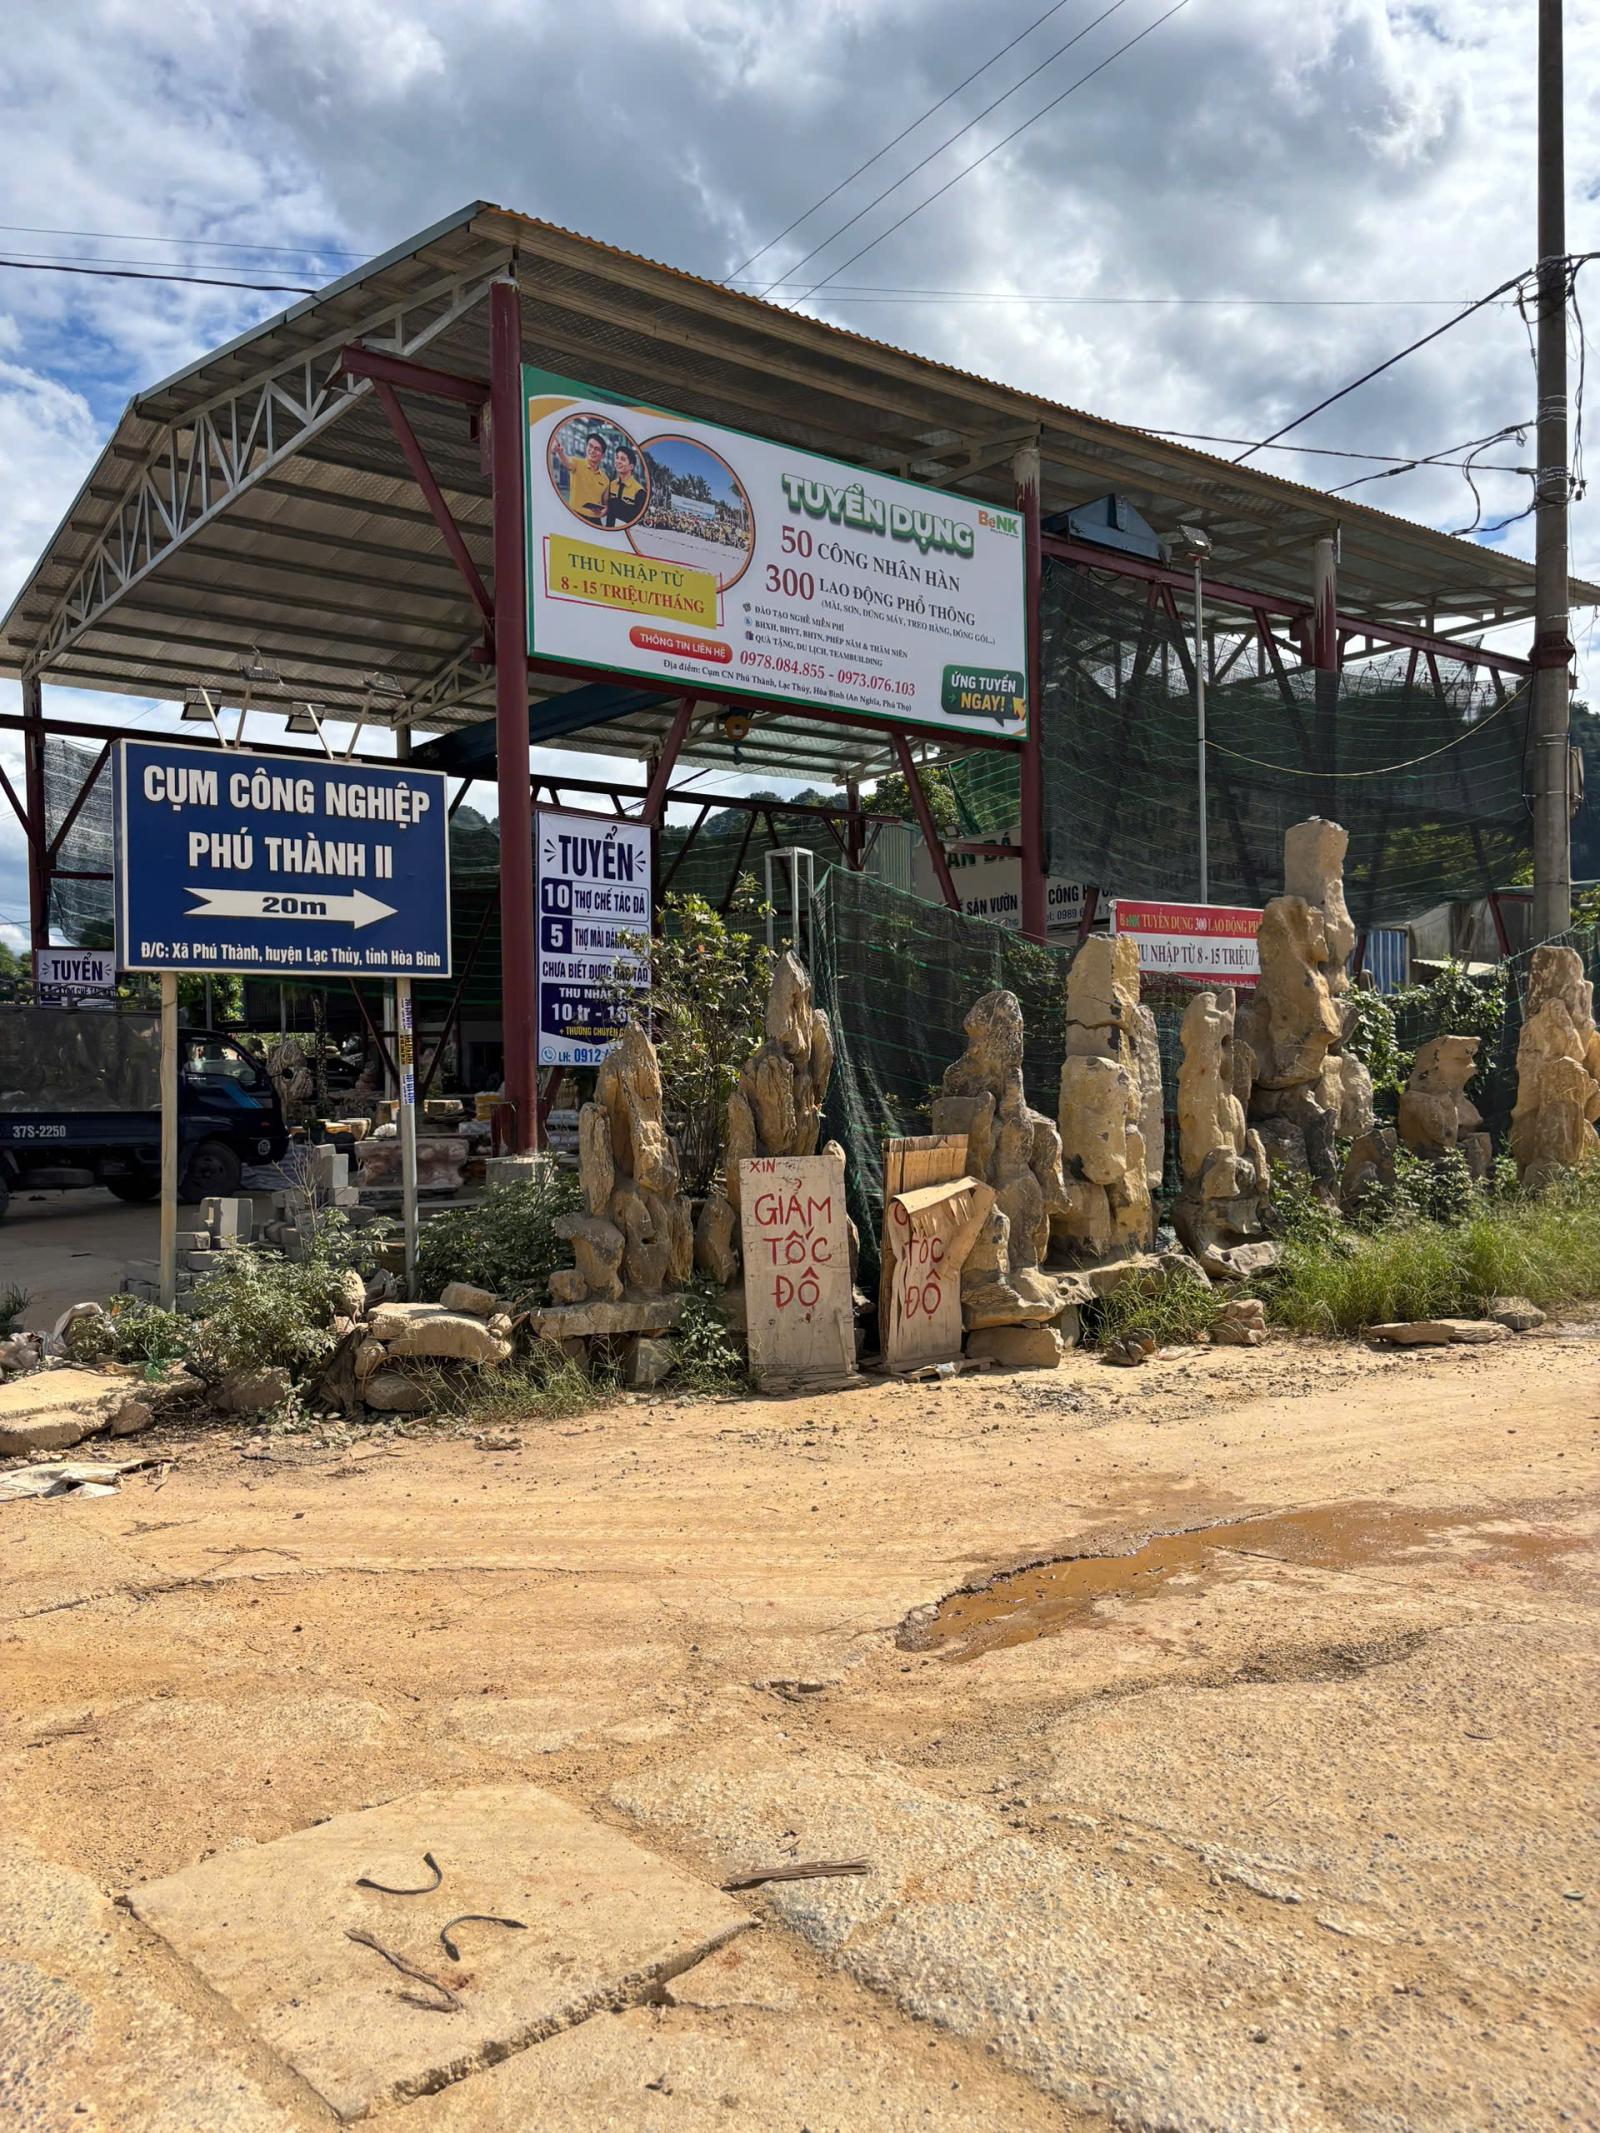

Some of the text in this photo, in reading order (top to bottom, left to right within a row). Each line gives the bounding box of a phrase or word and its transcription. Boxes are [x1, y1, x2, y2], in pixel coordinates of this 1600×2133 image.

[781, 473, 975, 556] TUYỂN DỤNG
[568, 553, 684, 587] THU NHẬP TỪ
[781, 525, 960, 592] 50 CÔNG NHÂN HÀN
[561, 576, 570, 590] 8
[583, 580, 598, 595] 15
[600, 583, 704, 613] TRIỆU/THÁNG
[765, 564, 976, 626] 300 LAO ĐỘNG PHỔ THÔNG
[907, 619, 928, 631] TREO
[640, 631, 675, 648] THÔNG
[676, 637, 691, 651] TIN
[692, 641, 713, 655] LIÊN
[721, 669, 735, 680] CN
[740, 650, 826, 680] 0978.084.855
[837, 669, 917, 697] 0973.076.103
[951, 671, 1016, 693] ỨNG TUYỂN
[961, 692, 1005, 713] NGAY!
[143, 765, 430, 829] CỤM CÔNG NGHIỆP
[189, 826, 393, 879] PHÚ THÀNH II
[559, 825, 634, 882] TUYỂN
[262, 896, 327, 916] 20m
[544, 883, 645, 914] 10 THỢ CHẾ TÁC ĐÁ
[1141, 908, 1170, 929] TUYỂN
[1171, 915, 1194, 933] DỤNG
[1208, 918, 1225, 932] LAO
[1225, 916, 1247, 936] ĐỘNG
[550, 924, 564, 948] 5
[575, 928, 589, 951] THỢ
[590, 926, 604, 948] MÀI
[51, 951, 103, 981] TUYỂN
[141, 942, 440, 967] Đ/C: Xã Phú Thành, huyện Lạc Thủy, tỉnh Hòa Bình
[542, 961, 566, 978] CHƯA
[568, 958, 587, 979] BIẾT
[1151, 941, 1179, 967] NHẬP
[1181, 942, 1196, 964] TỪ
[1197, 947, 1204, 964] 8
[1211, 948, 1220, 965] 15
[559, 987, 581, 998] THU
[551, 1003, 573, 1021] 10
[577, 1004, 591, 1021] tr
[558, 1051, 572, 1063] LH:
[762, 1227, 832, 1266] TỐC
[770, 1266, 820, 1323] ĐỘ
[904, 1268, 941, 1320] ĐỘ
